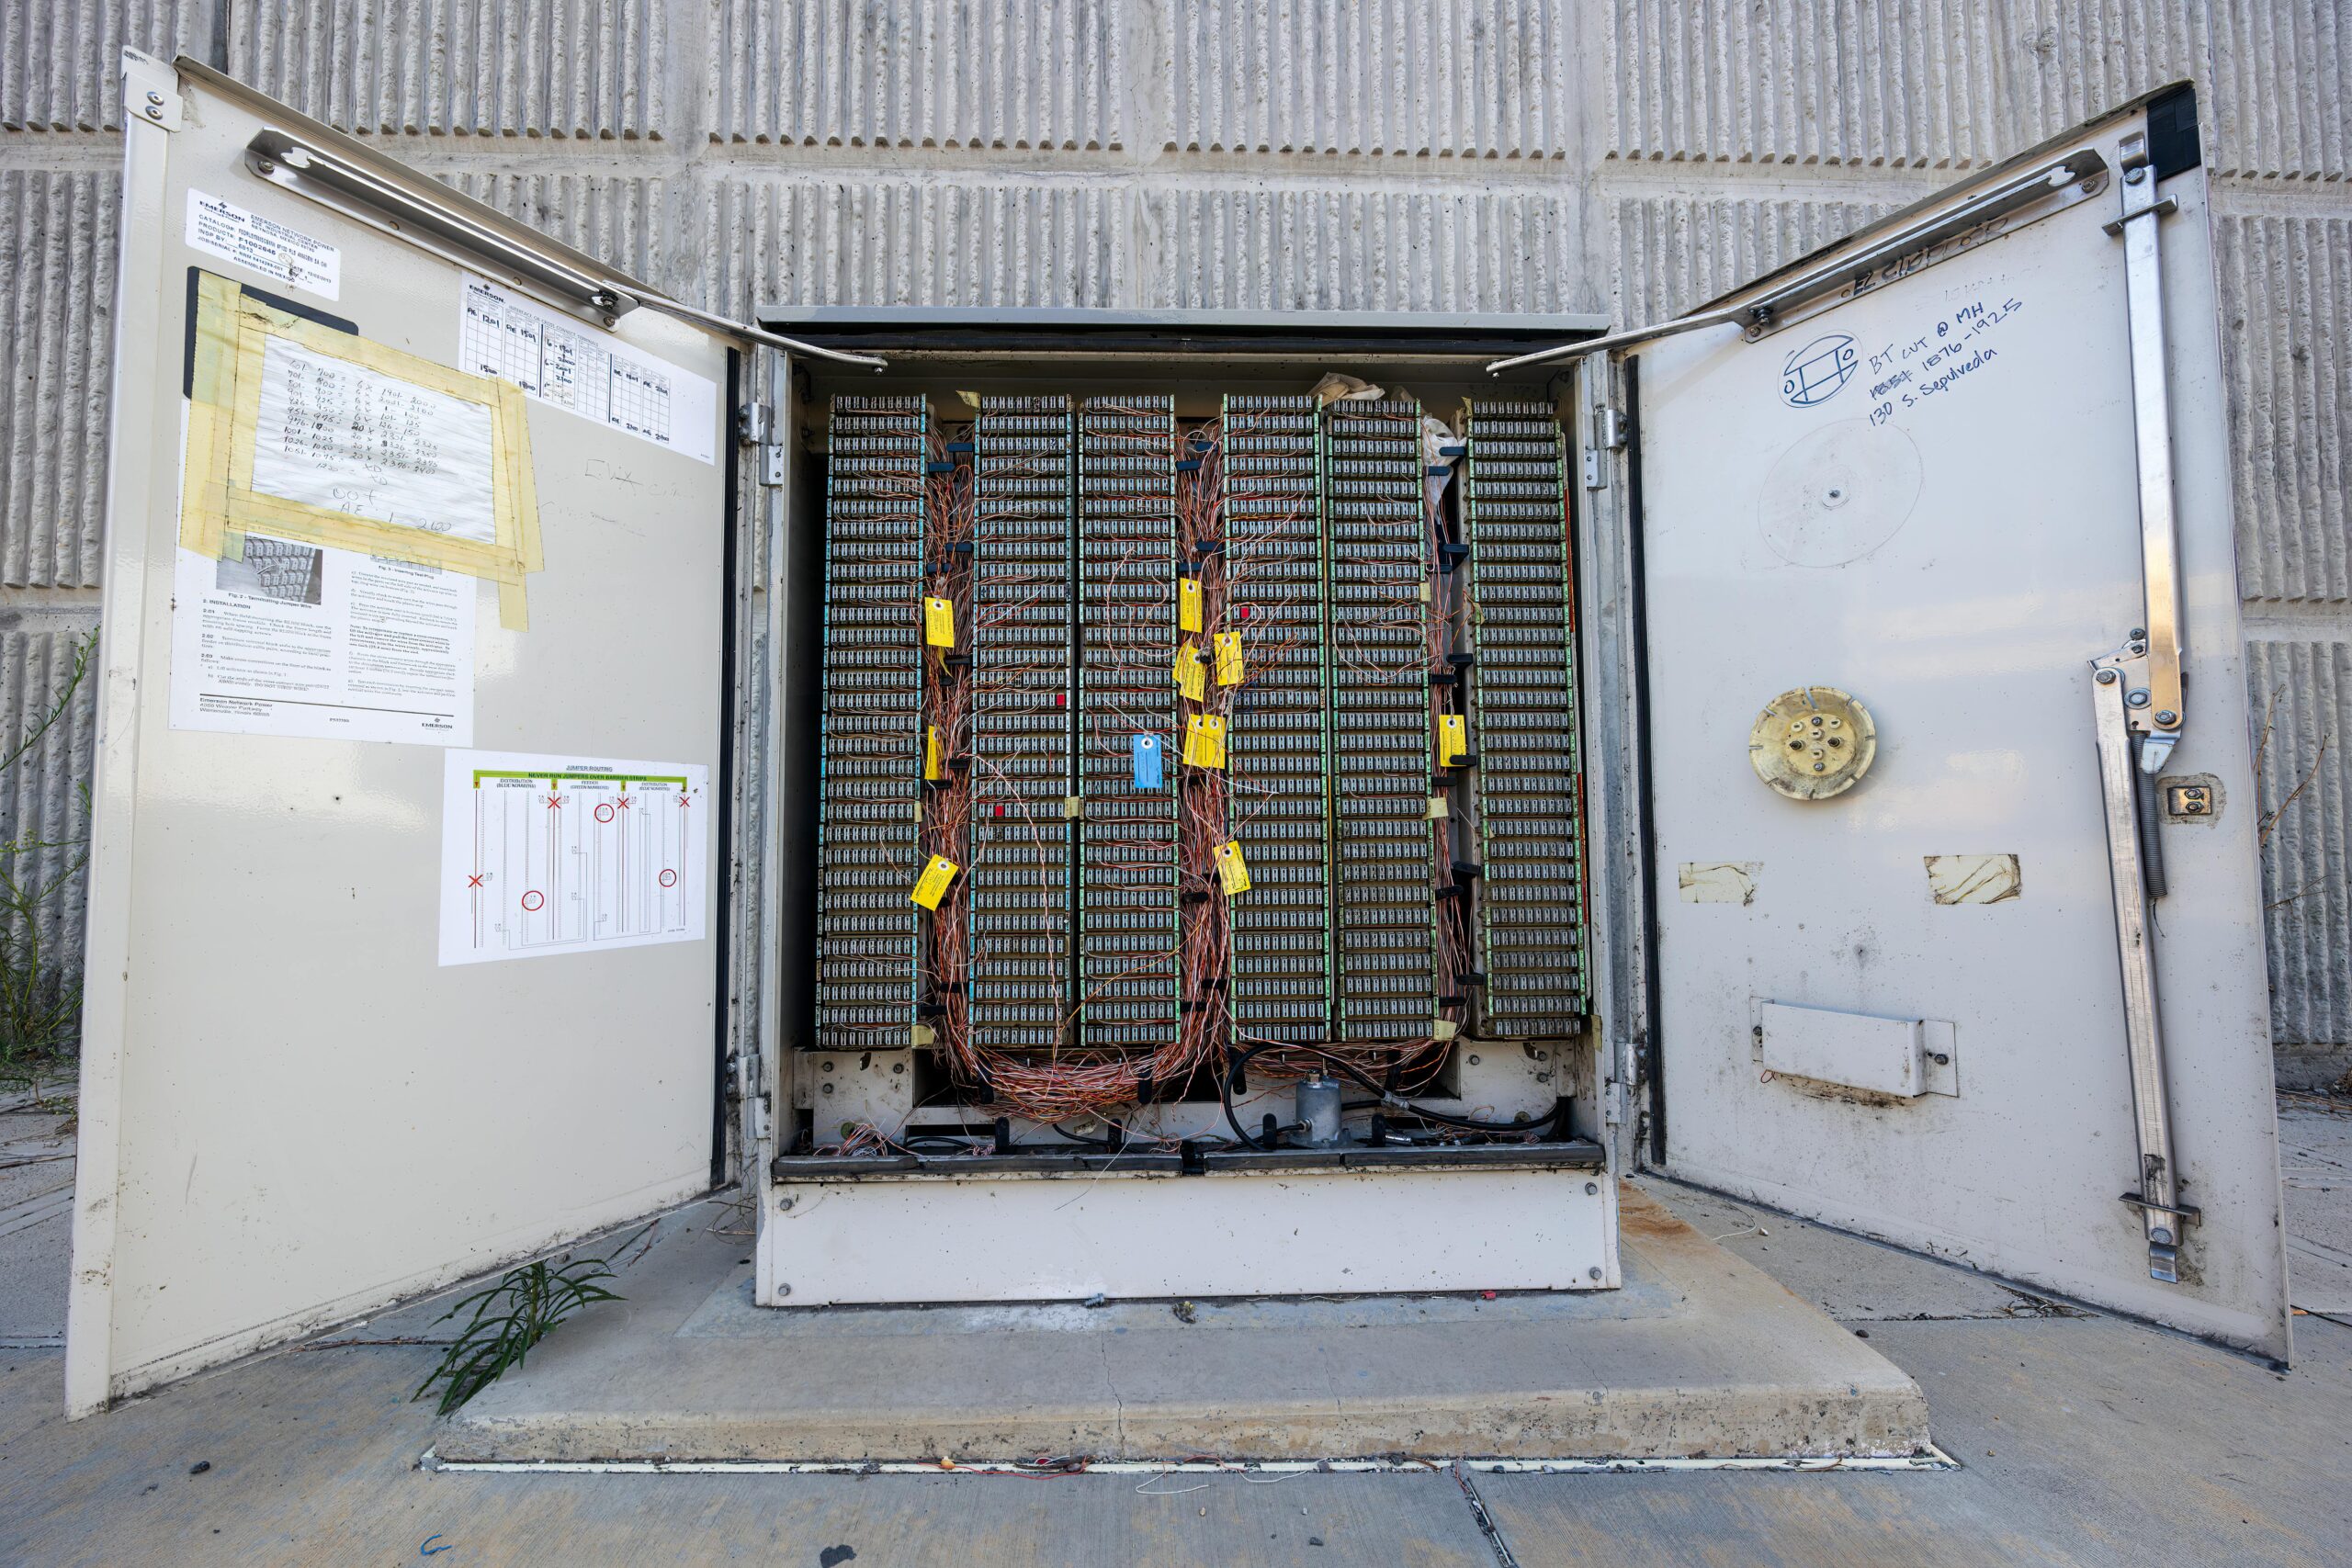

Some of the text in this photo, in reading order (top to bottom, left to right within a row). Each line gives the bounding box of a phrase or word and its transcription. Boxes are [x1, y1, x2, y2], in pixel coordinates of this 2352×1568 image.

[200, 200, 244, 222] EMERSON
[251, 214, 280, 230] EMERSON
[283, 226, 311, 243] NETWORK
[313, 237, 334, 252] POWER
[1869, 302, 1984, 375] BT CUT @ MH
[1870, 349, 1997, 426] 130 S. Sepulveda
[209, 600, 251, 609] INSTALLATION
